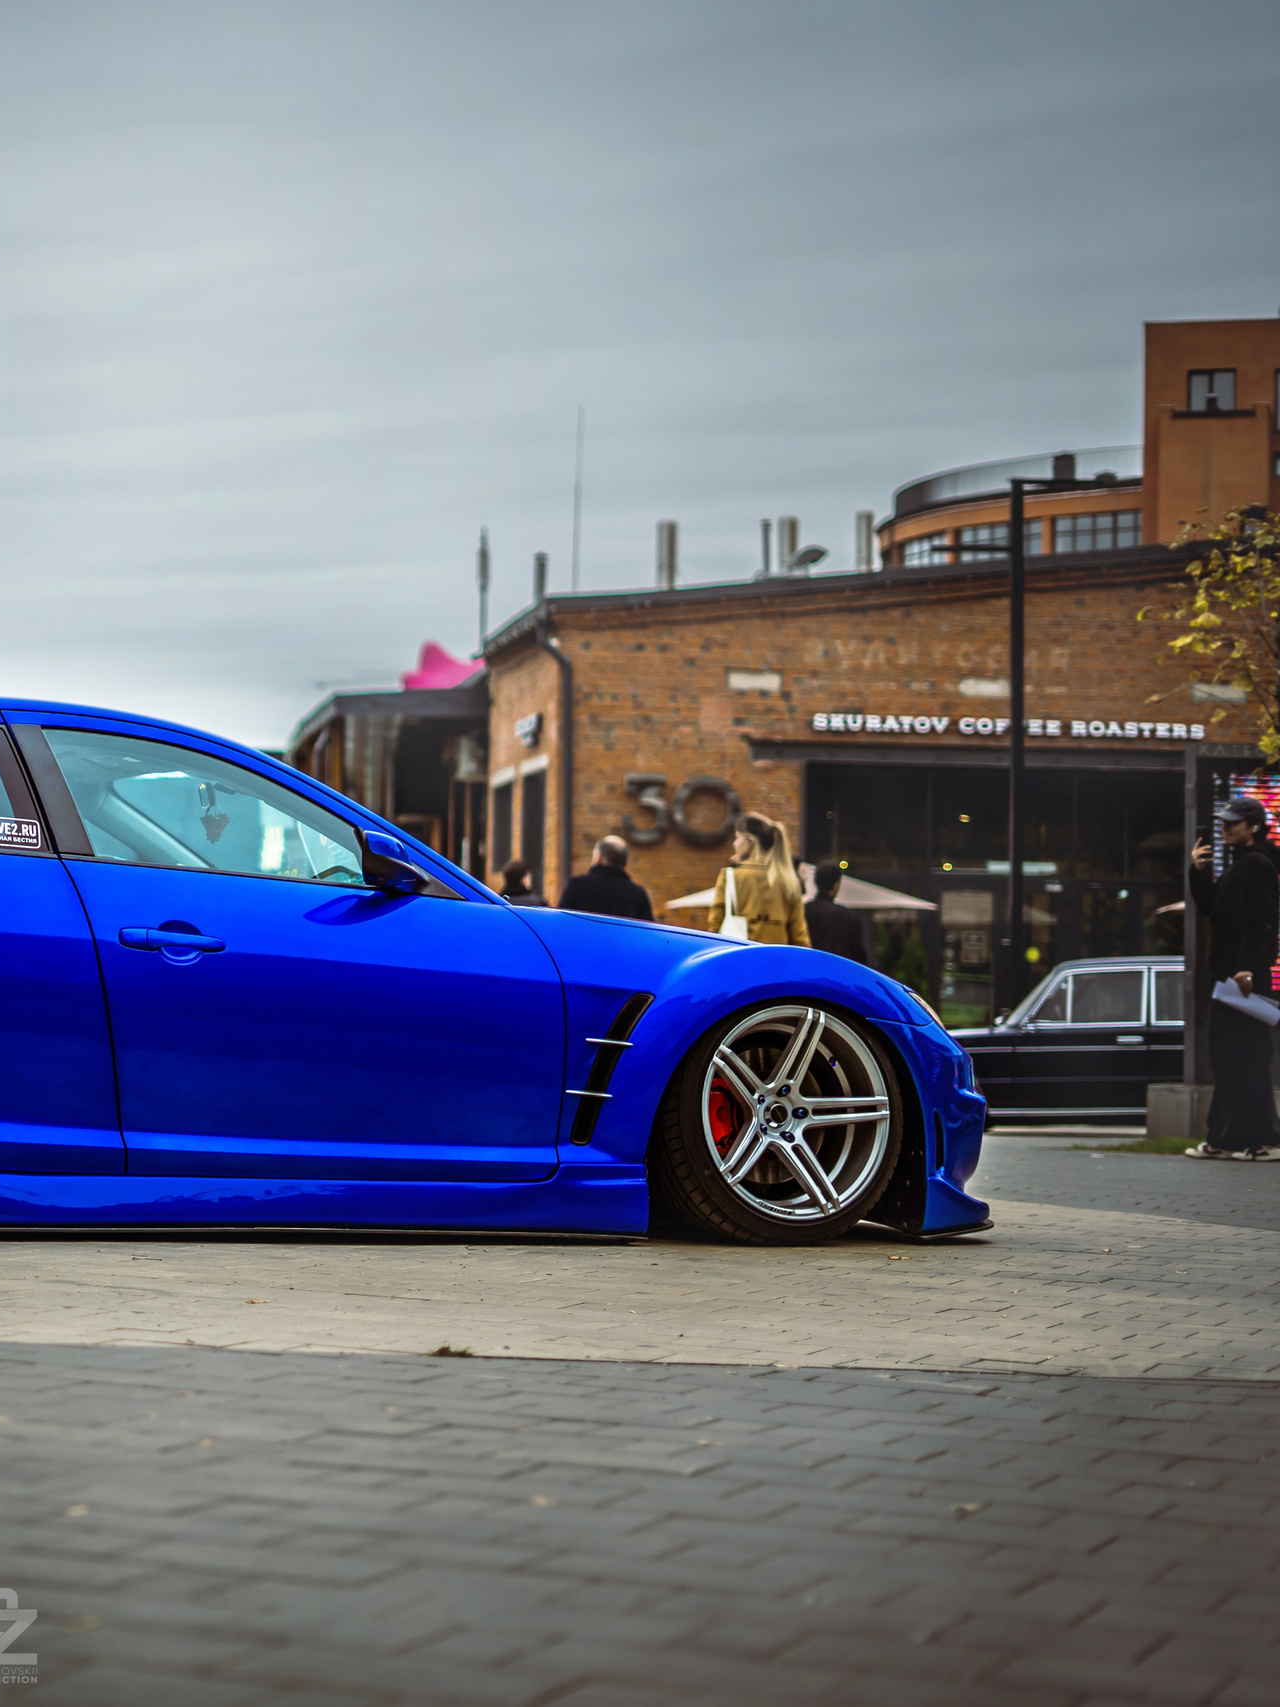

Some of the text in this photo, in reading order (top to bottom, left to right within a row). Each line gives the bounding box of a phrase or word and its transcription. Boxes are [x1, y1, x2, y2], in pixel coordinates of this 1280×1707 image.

[812, 712, 1205, 740] SKURATOV COFEE ROASTERS
[621, 773, 741, 848] 30
[13, 836, 37, 844] БЕСТИЯ
